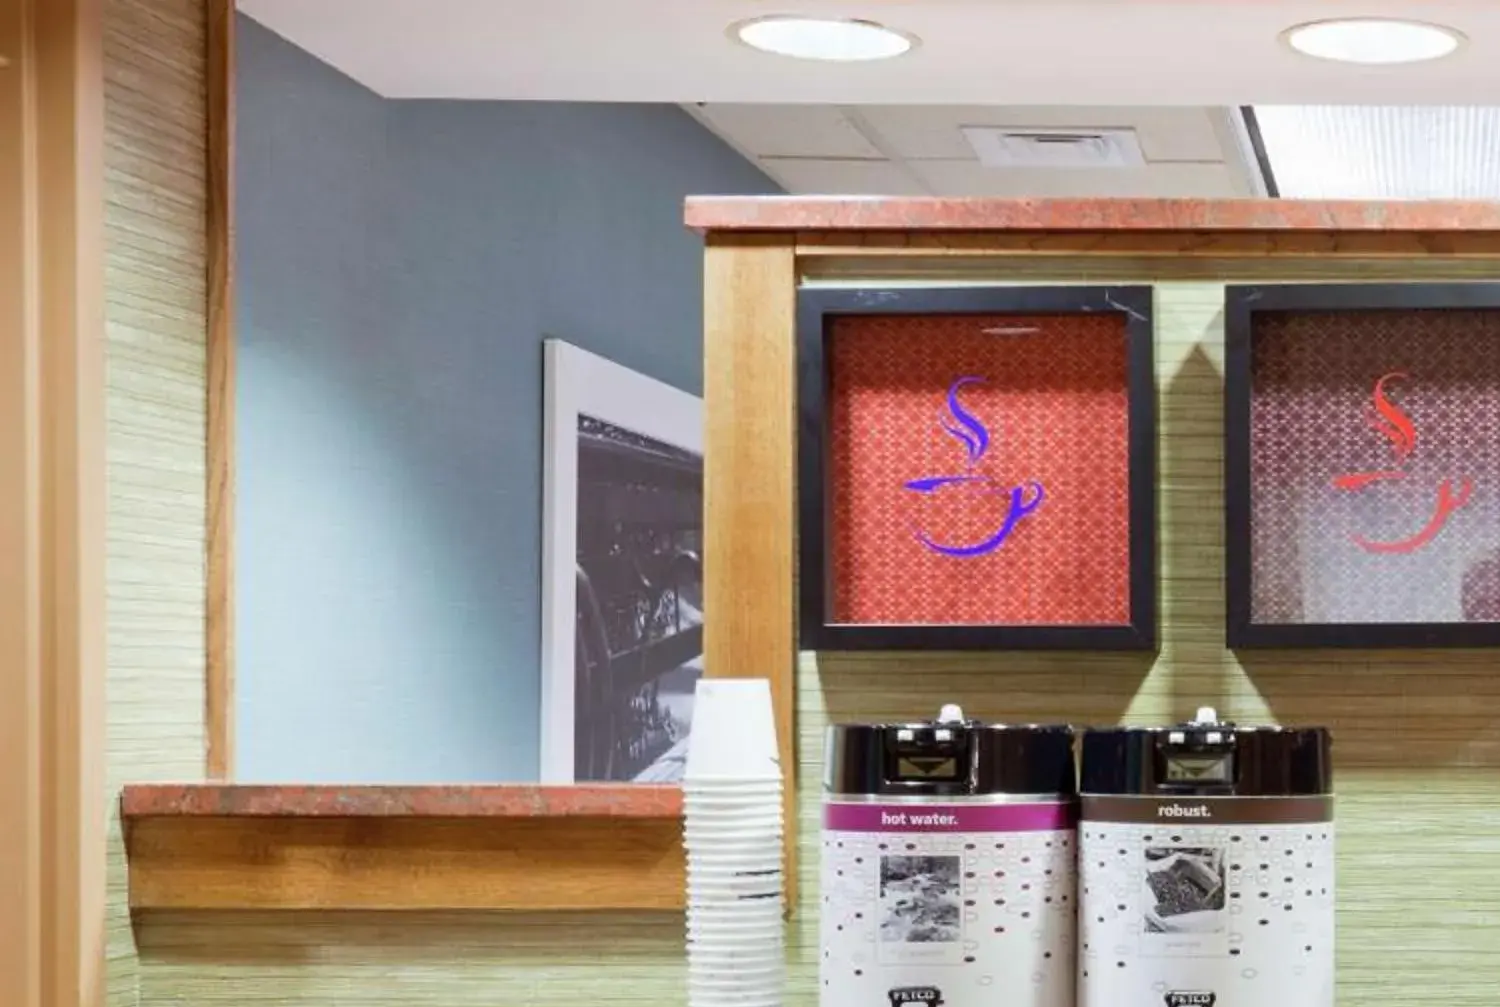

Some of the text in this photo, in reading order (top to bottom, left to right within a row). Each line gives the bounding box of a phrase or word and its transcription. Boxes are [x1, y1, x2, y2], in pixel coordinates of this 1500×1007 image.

[1158, 802, 1212, 817] robust.
[881, 811, 959, 826] hot water.
